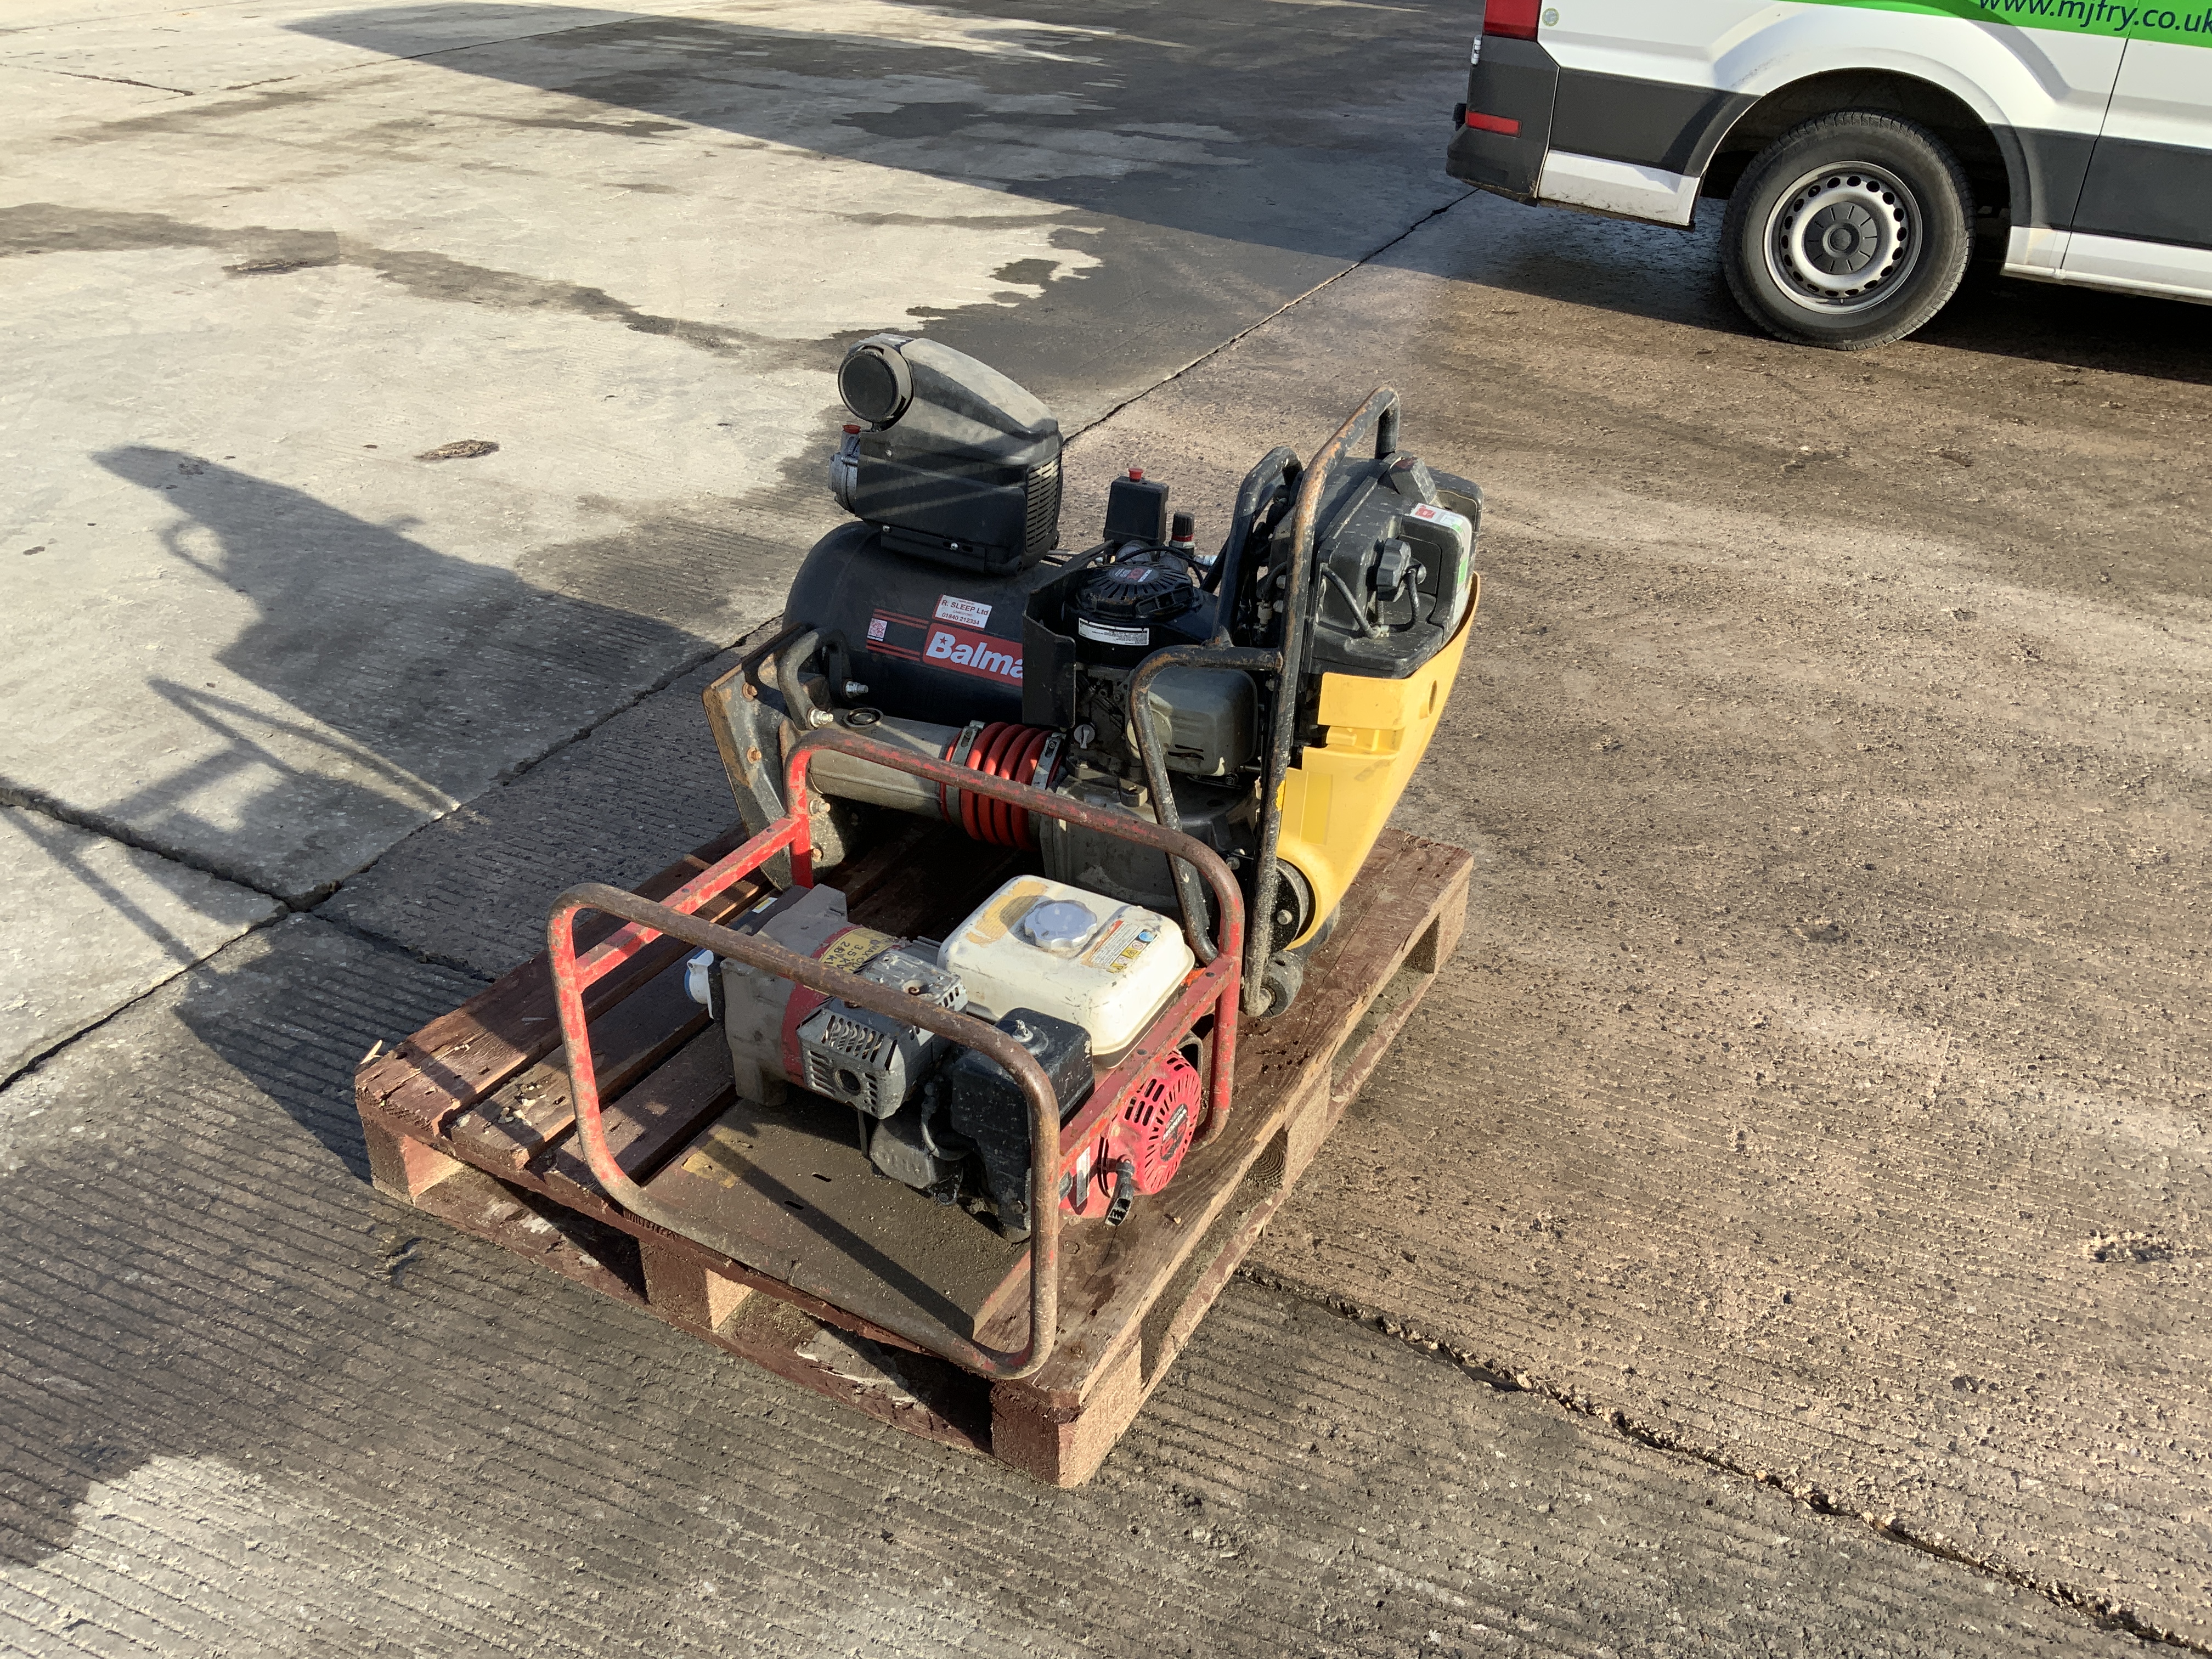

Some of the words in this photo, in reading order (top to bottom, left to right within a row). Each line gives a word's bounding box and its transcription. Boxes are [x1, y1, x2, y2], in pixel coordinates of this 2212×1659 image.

[951, 602, 975, 612] SLEEP
[942, 612, 958, 620] 01840
[960, 617, 980, 625] 212334
[847, 944, 864, 957] 3.5
